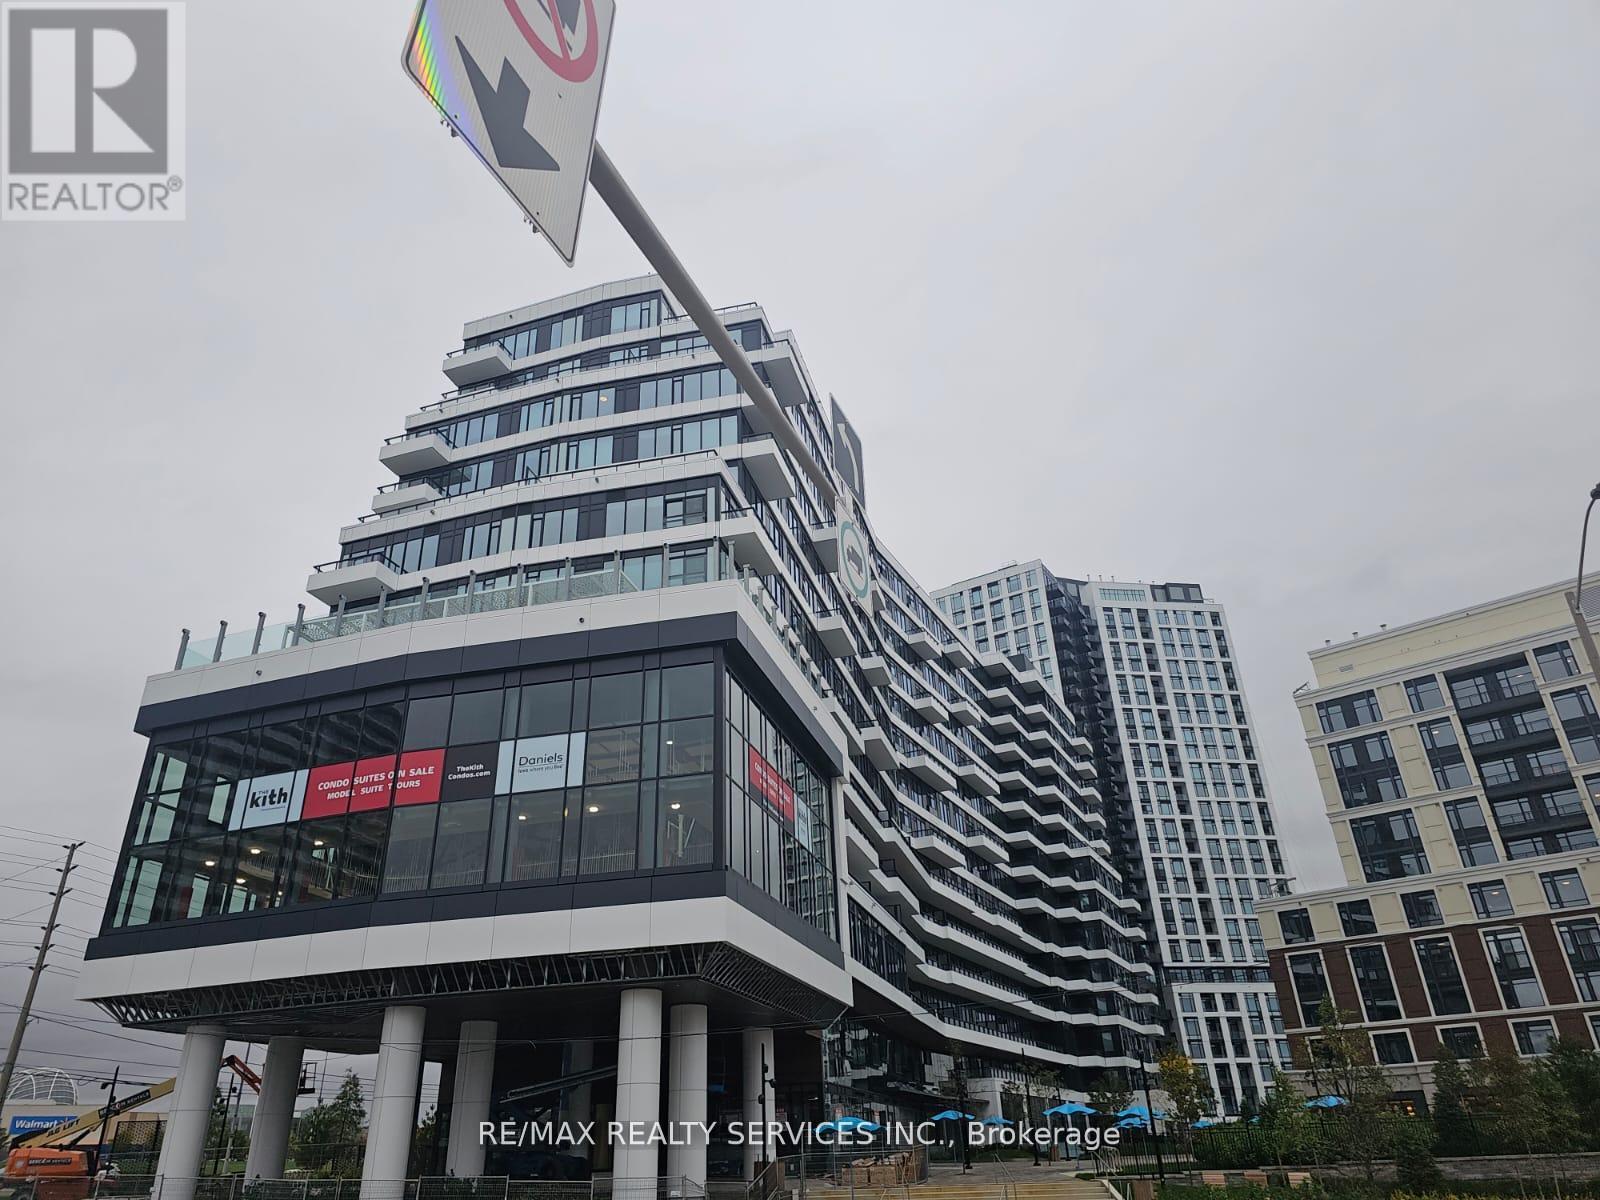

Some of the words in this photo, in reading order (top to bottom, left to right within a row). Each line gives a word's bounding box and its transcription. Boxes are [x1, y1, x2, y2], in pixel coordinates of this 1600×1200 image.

[519, 752, 564, 766] Daniels
[456, 763, 484, 772] TheKith
[318, 778, 350, 791] CONDO
[353, 772, 386, 785] SUITES
[387, 769, 406, 779] ON
[409, 766, 435, 777] SALE
[447, 770, 491, 780] Condos.com
[327, 789, 356, 800] MODEL
[361, 784, 385, 795] SUITE
[388, 780, 421, 791] TOURS
[249, 787, 288, 809] kith
[15, 1119, 57, 1130] Walmart
